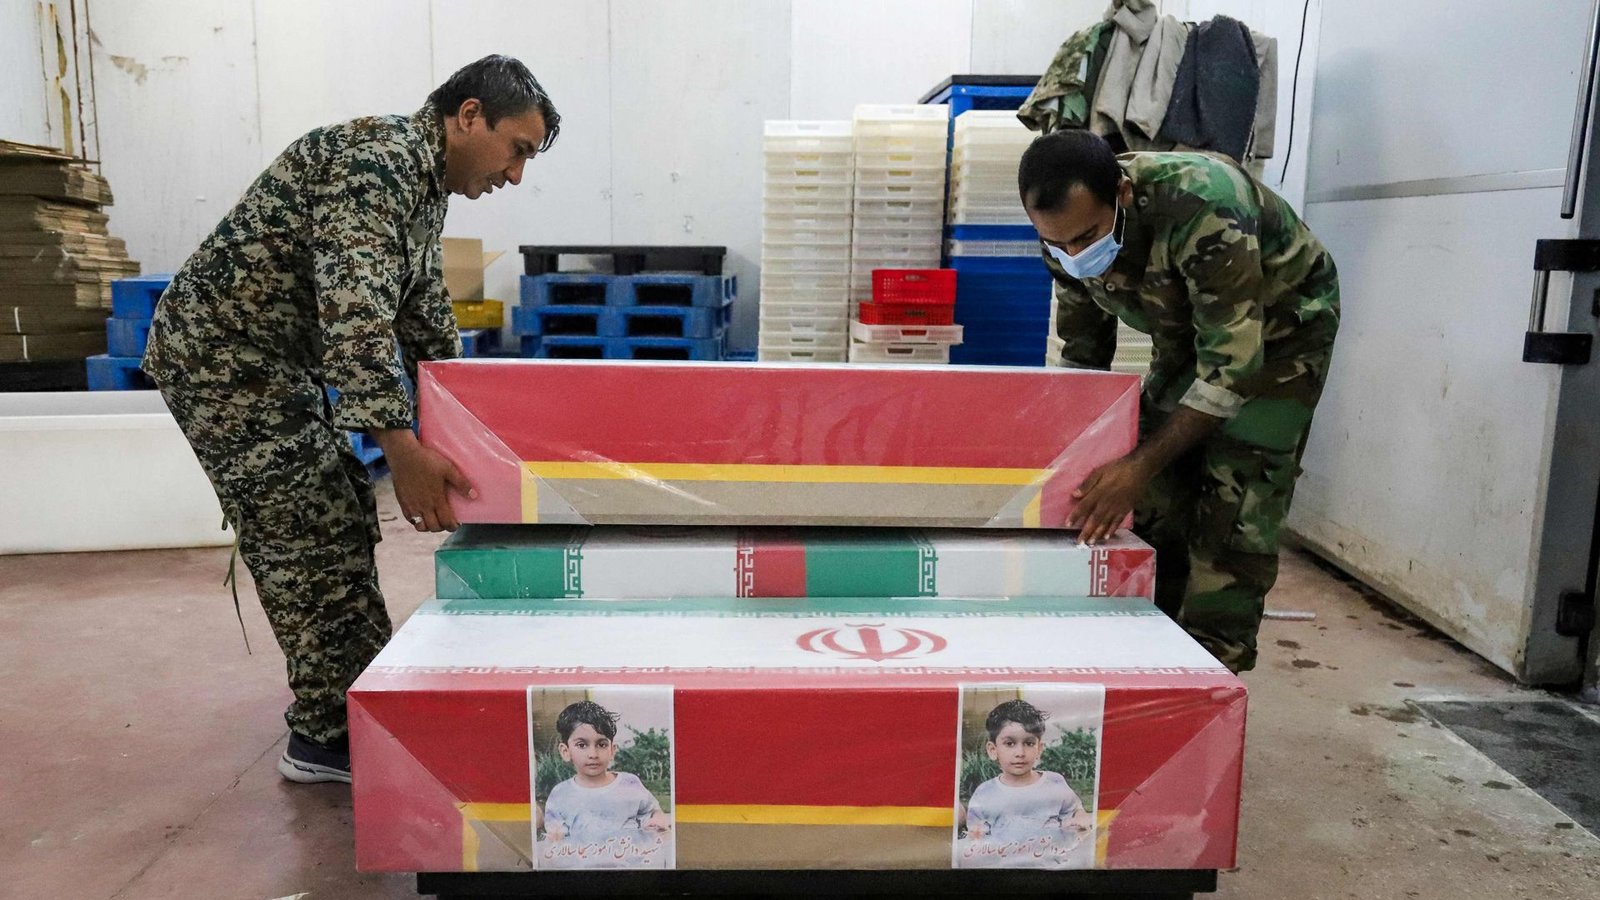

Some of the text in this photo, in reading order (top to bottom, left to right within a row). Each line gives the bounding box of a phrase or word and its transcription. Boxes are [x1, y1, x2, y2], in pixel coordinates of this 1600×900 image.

[544, 845, 576, 859] سالاری
[592, 838, 615, 855] آموز
[614, 837, 638, 858] دانش
